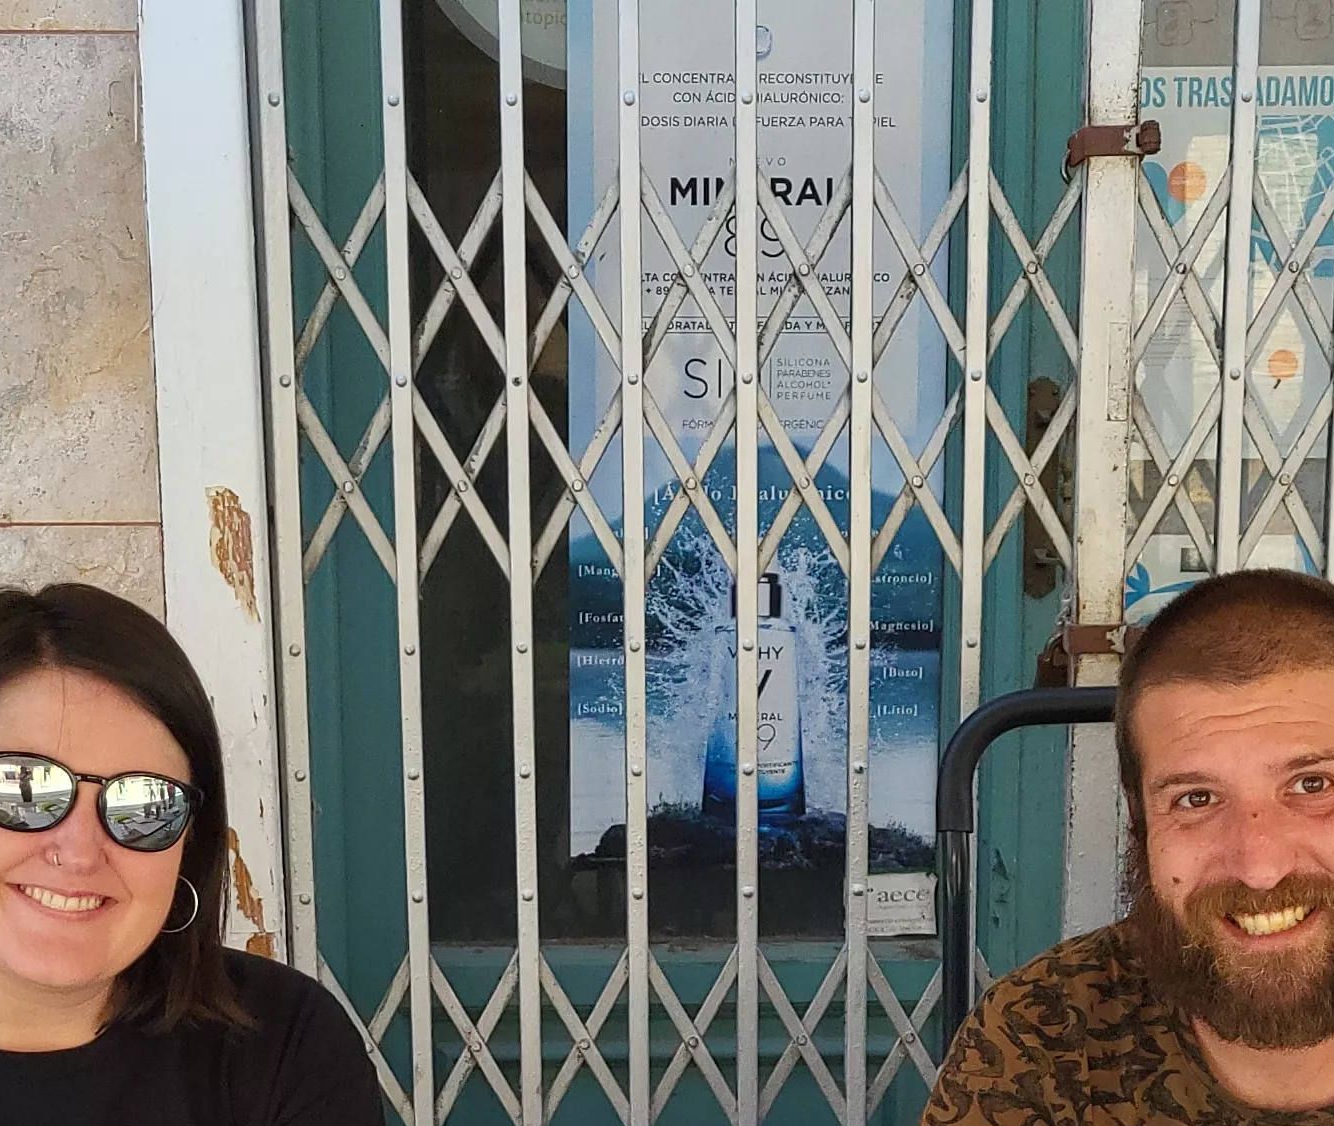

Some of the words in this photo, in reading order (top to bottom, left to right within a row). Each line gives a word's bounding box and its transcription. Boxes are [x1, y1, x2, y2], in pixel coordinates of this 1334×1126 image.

[653, 73, 736, 84] CONCENTRA
[673, 92, 701, 103] CON
[706, 89, 736, 103] ÁCID
[641, 116, 680, 127] DOSIS
[684, 116, 728, 127] DIARIA
[809, 116, 844, 127] PARA
[873, 116, 896, 127] IEL
[670, 177, 833, 206] MIRA
[869, 619, 934, 633] Magnesio]
[727, 646, 784, 660] VHY
